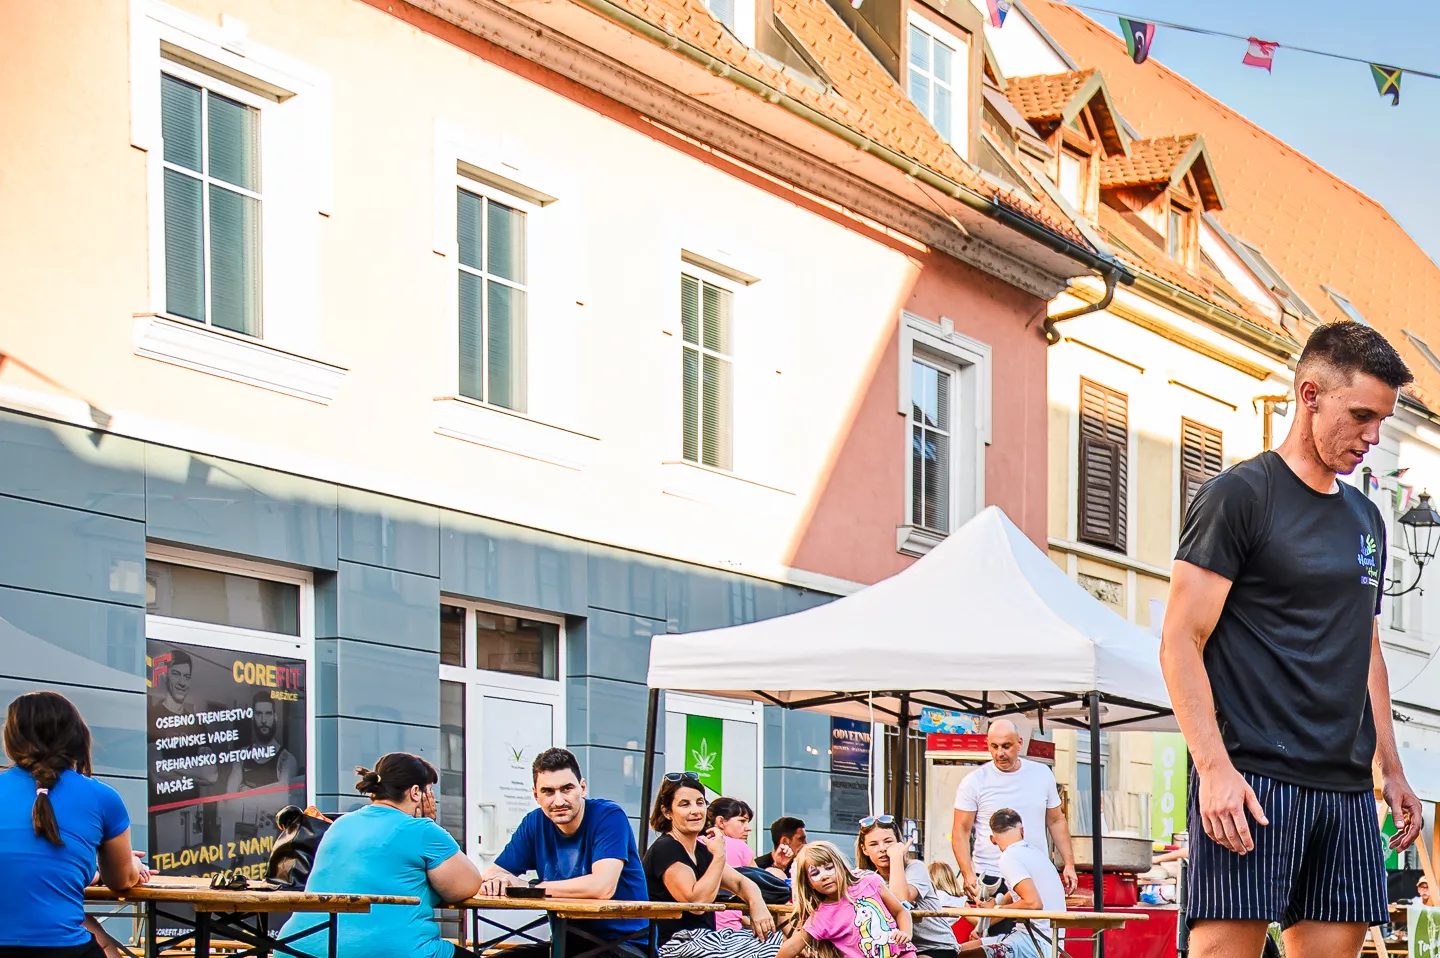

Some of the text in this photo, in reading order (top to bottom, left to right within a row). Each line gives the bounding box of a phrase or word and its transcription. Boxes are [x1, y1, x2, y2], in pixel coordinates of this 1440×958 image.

[232, 660, 301, 691] COREFIT
[270, 690, 299, 702] BREŽICE
[155, 707, 254, 729] OSEBNO TRENERSTVO
[155, 729, 239, 751] SKUPINSKE VADBE
[155, 745, 276, 773] PREHRANSKO SVETOVANJE
[156, 776, 195, 795] MASAŽE
[152, 843, 224, 870] TELOVADI
[227, 842, 238, 859] Z
